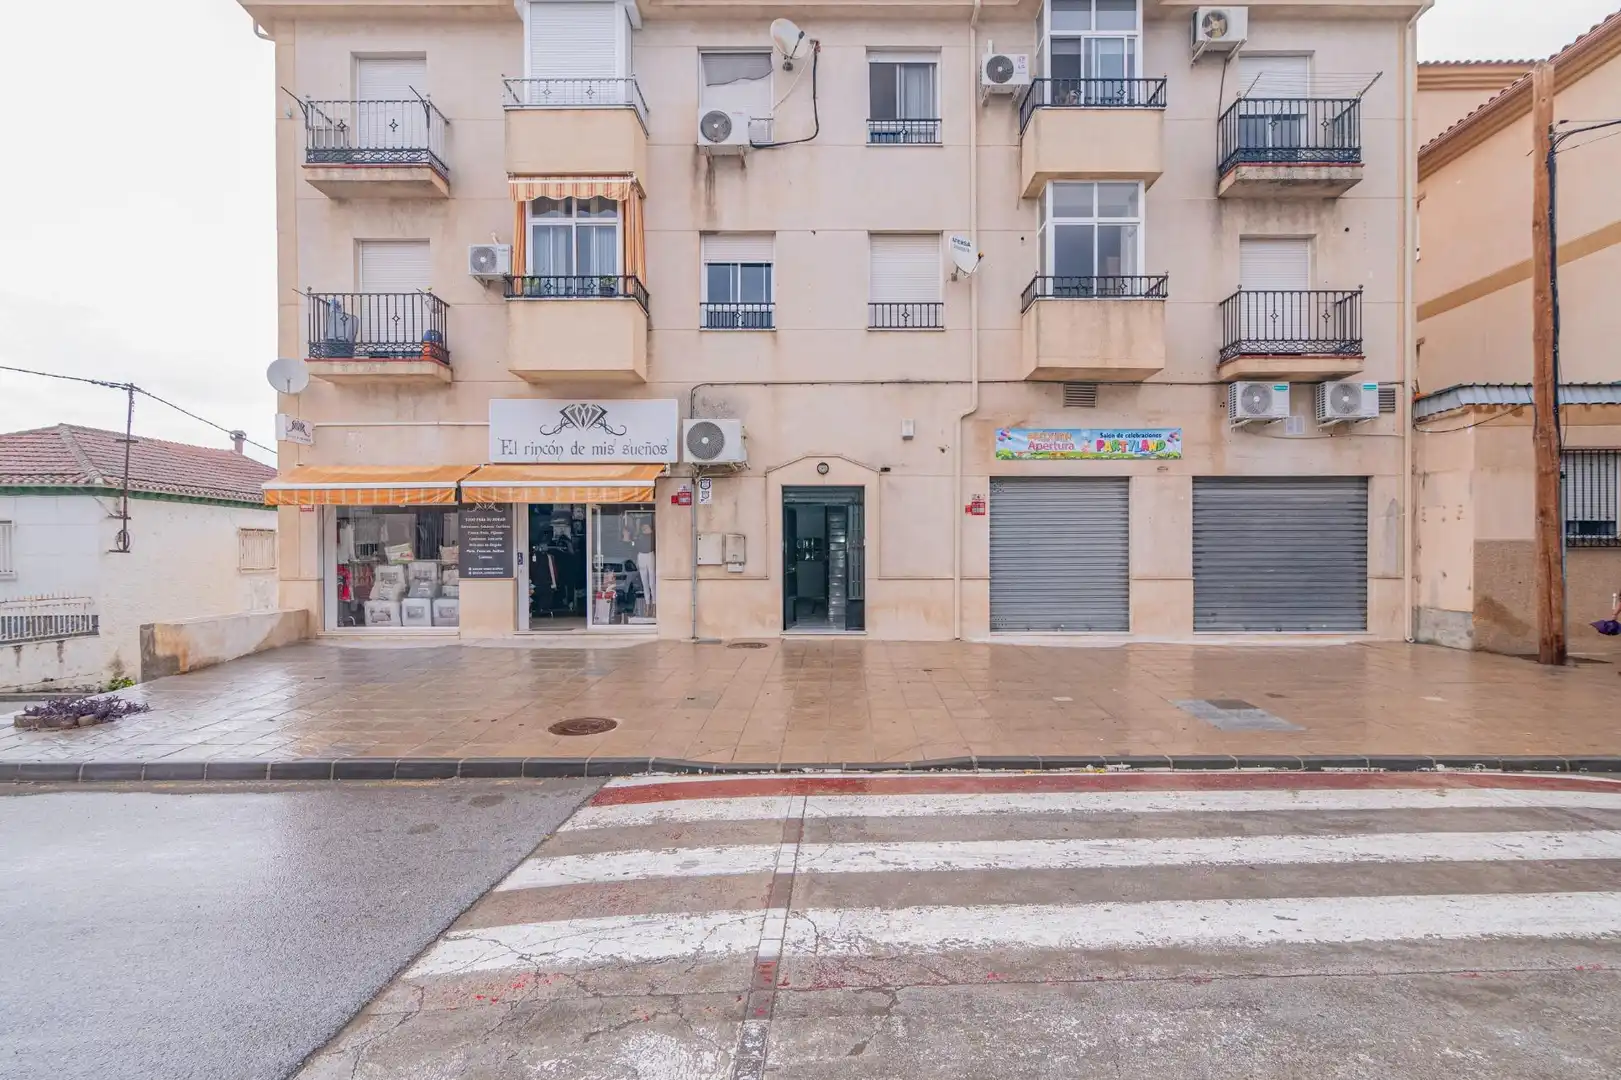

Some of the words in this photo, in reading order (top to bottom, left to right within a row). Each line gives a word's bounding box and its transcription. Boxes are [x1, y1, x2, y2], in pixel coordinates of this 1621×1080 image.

[498, 438, 517, 455] El
[524, 439, 564, 462] rincón
[570, 440, 585, 456] de
[591, 439, 617, 456] mis
[622, 438, 670, 456] sueños
[1027, 440, 1076, 451] Apertura
[1096, 439, 1166, 453] PARTYLAND
